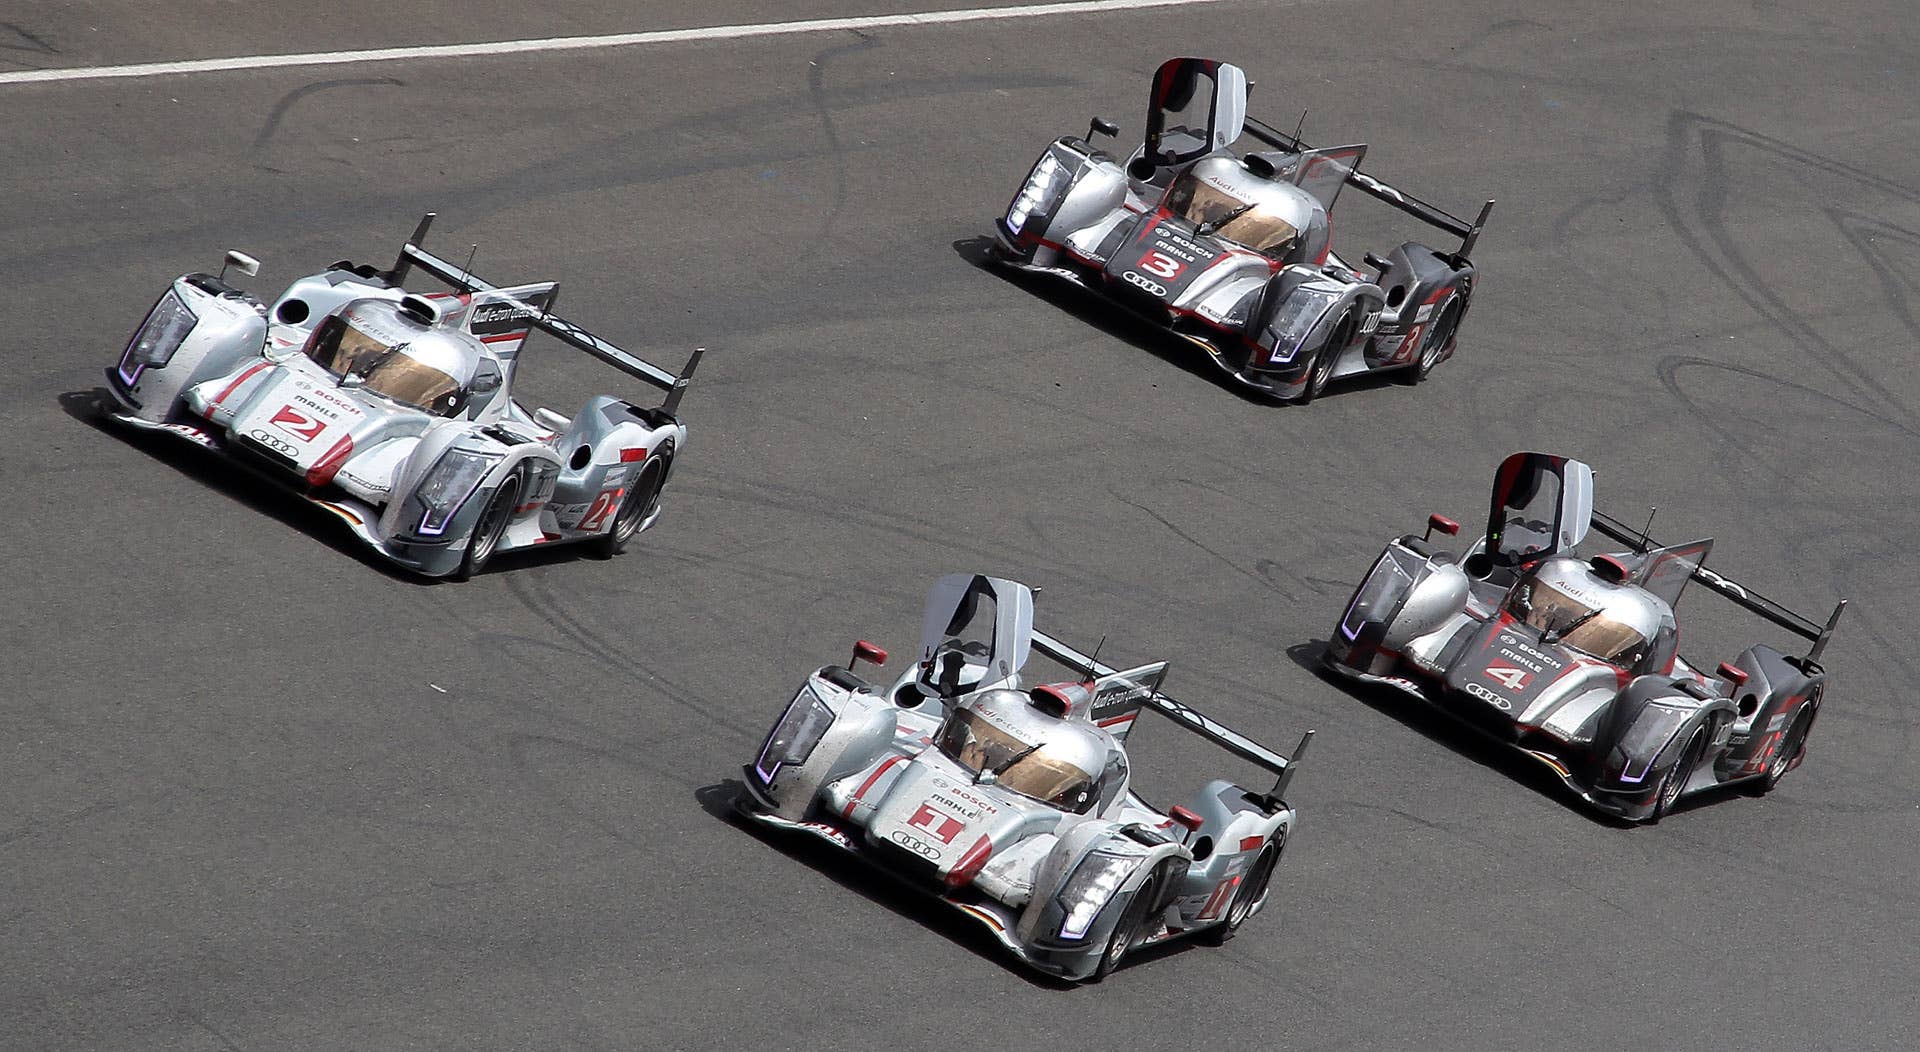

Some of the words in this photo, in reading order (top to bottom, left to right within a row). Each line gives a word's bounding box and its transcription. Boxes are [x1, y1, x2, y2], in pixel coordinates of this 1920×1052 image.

[1155, 240, 1195, 262] MAHLE
[1172, 235, 1214, 259] BOSCH
[1141, 252, 1180, 278] 3
[1396, 325, 1420, 359] 3
[294, 395, 338, 419] MAHLE
[314, 389, 361, 415] BOSCH
[270, 408, 320, 441] 2
[581, 492, 610, 528] 2
[1555, 579, 1584, 597] Audi
[1500, 648, 1543, 673] MAHLE
[1518, 643, 1561, 669] BOSCH
[1485, 667, 1527, 689] 4
[1749, 735, 1773, 770] 4
[931, 794, 975, 819] MAHLE
[952, 788, 997, 814] BOSCH
[913, 808, 950, 840] 1
[1202, 881, 1229, 918] 1
